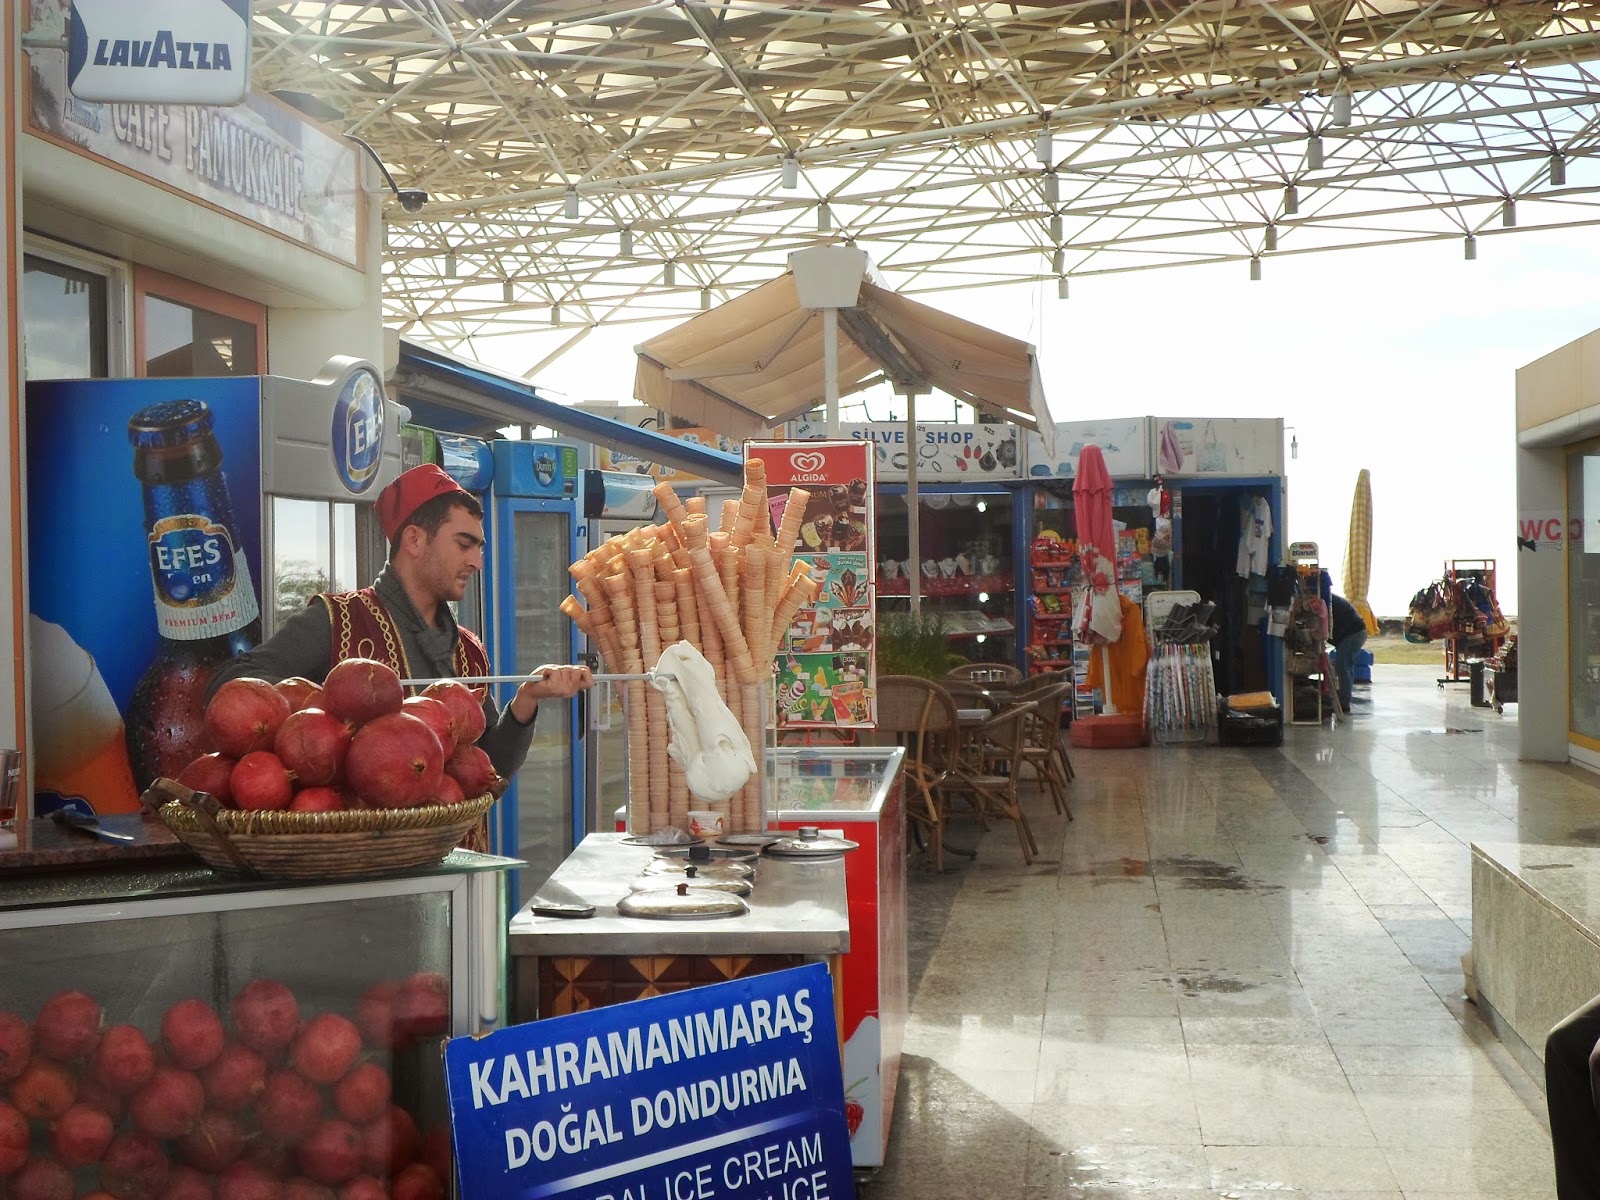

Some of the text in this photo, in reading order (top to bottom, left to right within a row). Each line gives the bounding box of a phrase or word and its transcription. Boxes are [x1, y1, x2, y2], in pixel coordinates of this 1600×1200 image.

[93, 30, 232, 71] LAVAZZA
[185, 105, 304, 222] PAMUKKALE
[852, 428, 974, 444] SİLVE SHOP
[1519, 518, 1561, 542] WC
[156, 539, 221, 570] EFES
[164, 610, 237, 627] PREMIUM BEER
[469, 989, 814, 1109] KAHRAMANMARAŞ
[505, 1057, 806, 1170] DOĞAL DONDURMA
[665, 1132, 823, 1200] ICE CREAM
[782, 1170, 829, 1200] ICE
